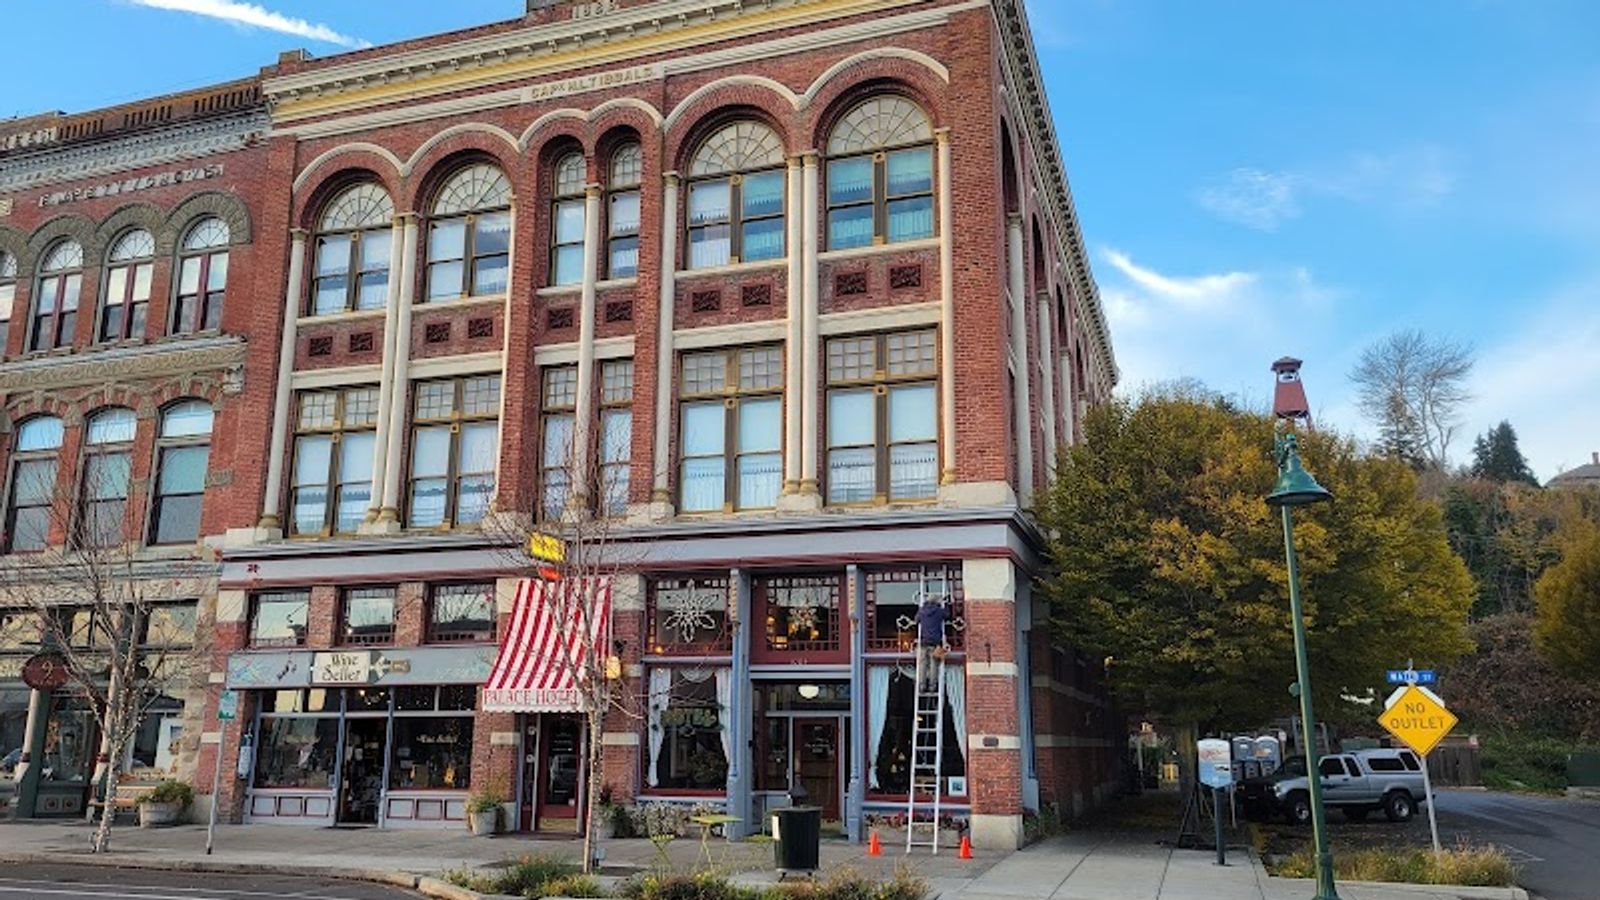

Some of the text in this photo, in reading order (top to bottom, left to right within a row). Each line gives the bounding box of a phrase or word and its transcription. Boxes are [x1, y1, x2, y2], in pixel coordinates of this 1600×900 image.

[331, 653, 359, 668] Wine
[322, 664, 361, 681] Seller
[483, 689, 579, 706] PALACE HOTEL
[1405, 702, 1425, 714] NO
[1390, 716, 1444, 729] OUTLET
